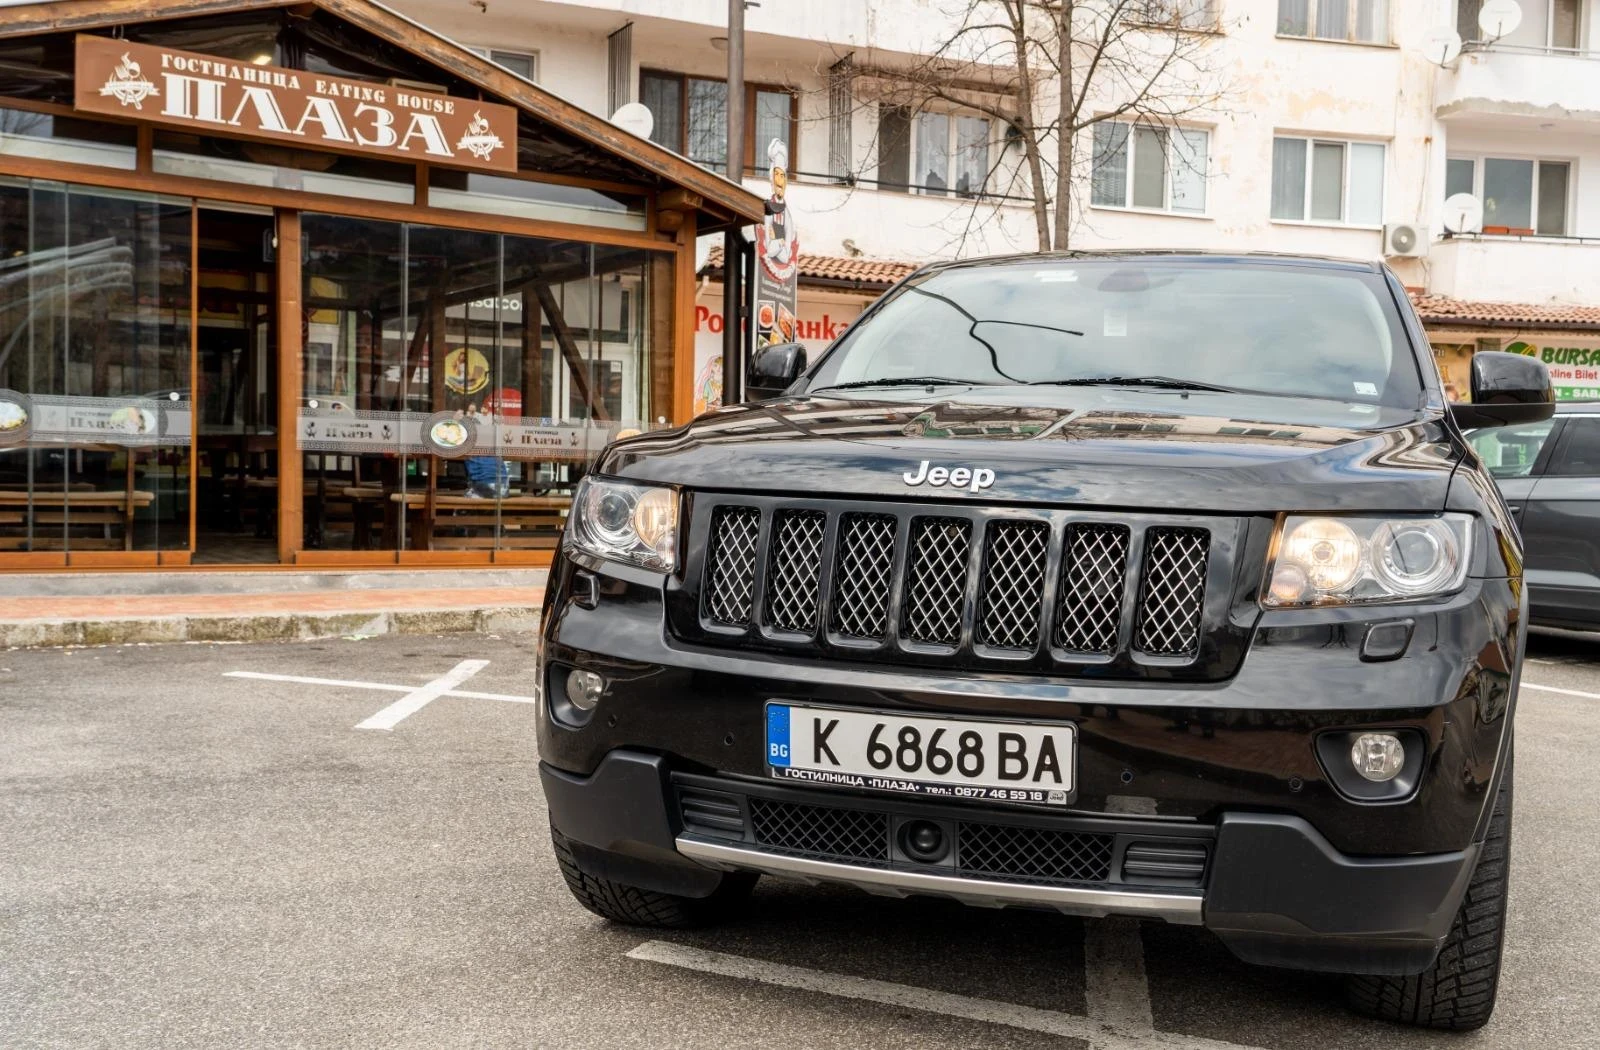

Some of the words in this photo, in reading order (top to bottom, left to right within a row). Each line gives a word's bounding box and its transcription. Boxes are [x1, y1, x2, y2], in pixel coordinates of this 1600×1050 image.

[161, 53, 301, 92] ГОСТИЛНИЦА
[161, 72, 456, 158] ПЛАЗА
[315, 81, 386, 105] EATING
[397, 92, 456, 115] HOUSE
[1550, 369, 1572, 379] nline
[1575, 369, 1598, 380] Bilet
[1572, 388, 1600, 399] SAB
[903, 460, 995, 494] Jeep
[770, 743, 788, 758] BG
[813, 717, 841, 766] K
[866, 723, 985, 778] 6868
[997, 732, 1063, 784] BA
[785, 767, 865, 787] ГОСТИЛНИЦА
[954, 786, 987, 798] 0877
[989, 789, 1007, 799] 46
[1009, 790, 1027, 801] 59
[1029, 791, 1043, 801] 18
